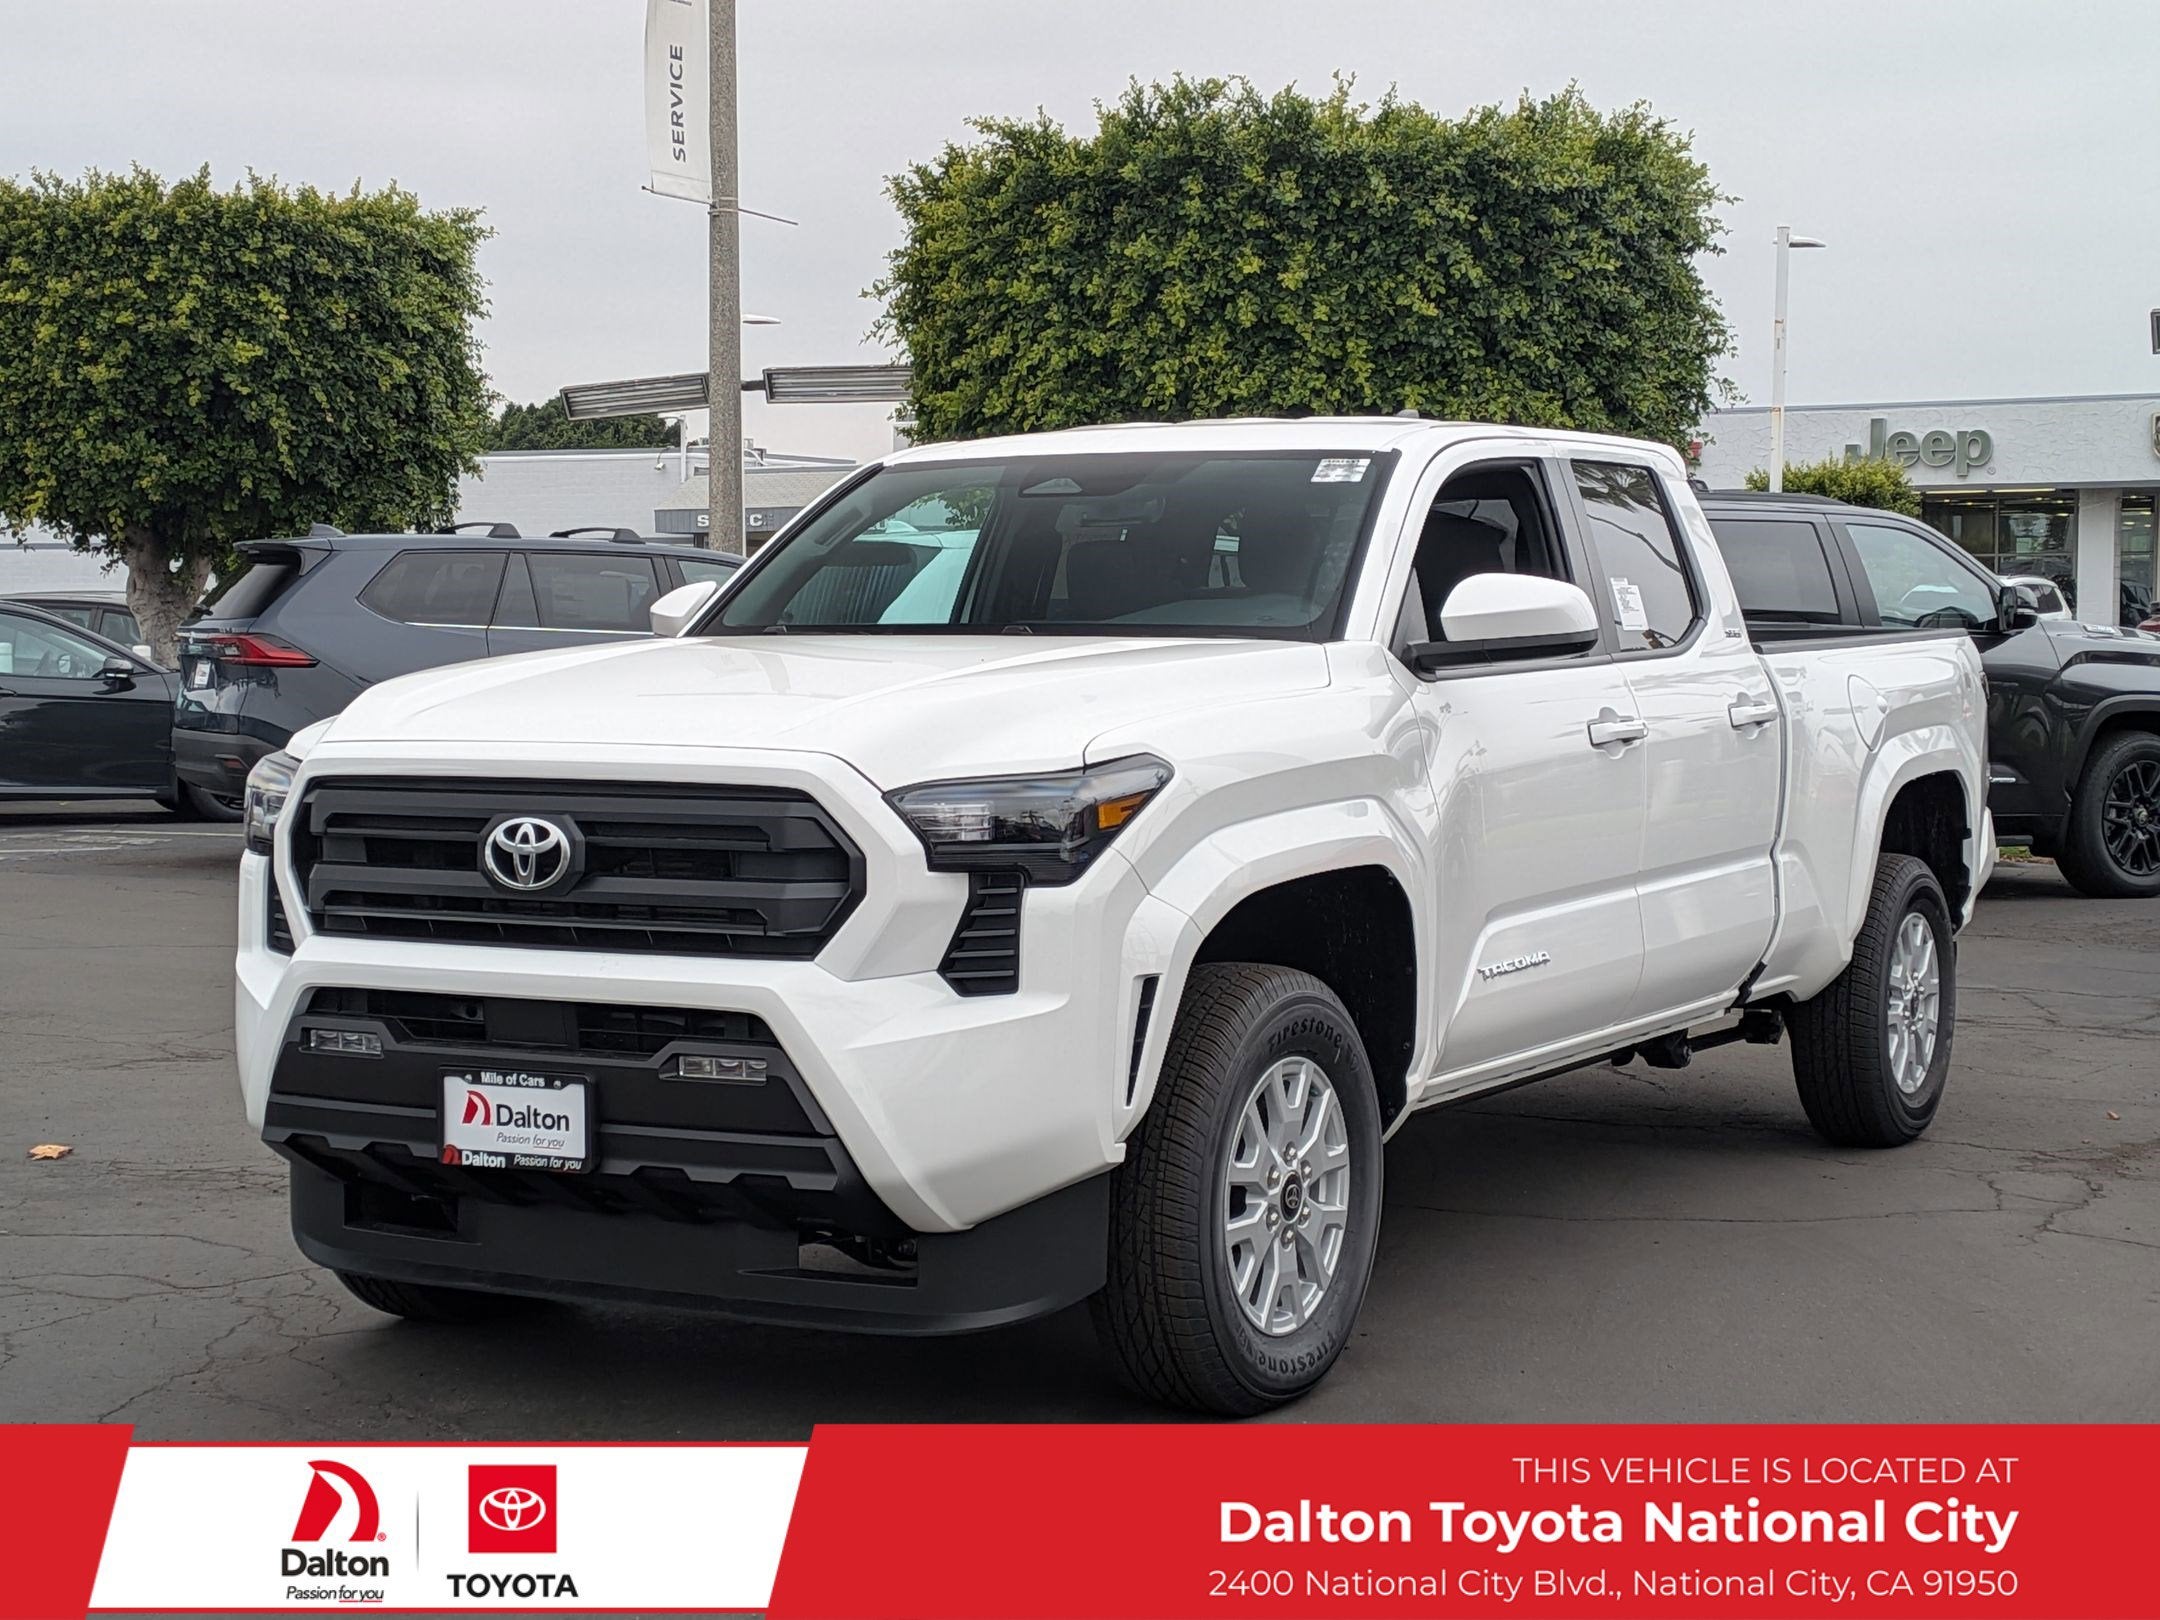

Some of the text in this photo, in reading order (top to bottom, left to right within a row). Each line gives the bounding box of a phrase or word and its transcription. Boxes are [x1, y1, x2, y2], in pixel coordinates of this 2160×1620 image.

[669, 44, 687, 163] SERVICE
[1845, 417, 1993, 477] Jeep
[1477, 951, 1551, 981] TACOMA
[1267, 1016, 1343, 1056] Firestone
[481, 1071, 545, 1088] Mile of Cars
[495, 1103, 570, 1132] Dalton
[496, 1131, 565, 1149] Passion for you
[461, 1150, 506, 1168] Dalton
[513, 1154, 582, 1171] Passion for you
